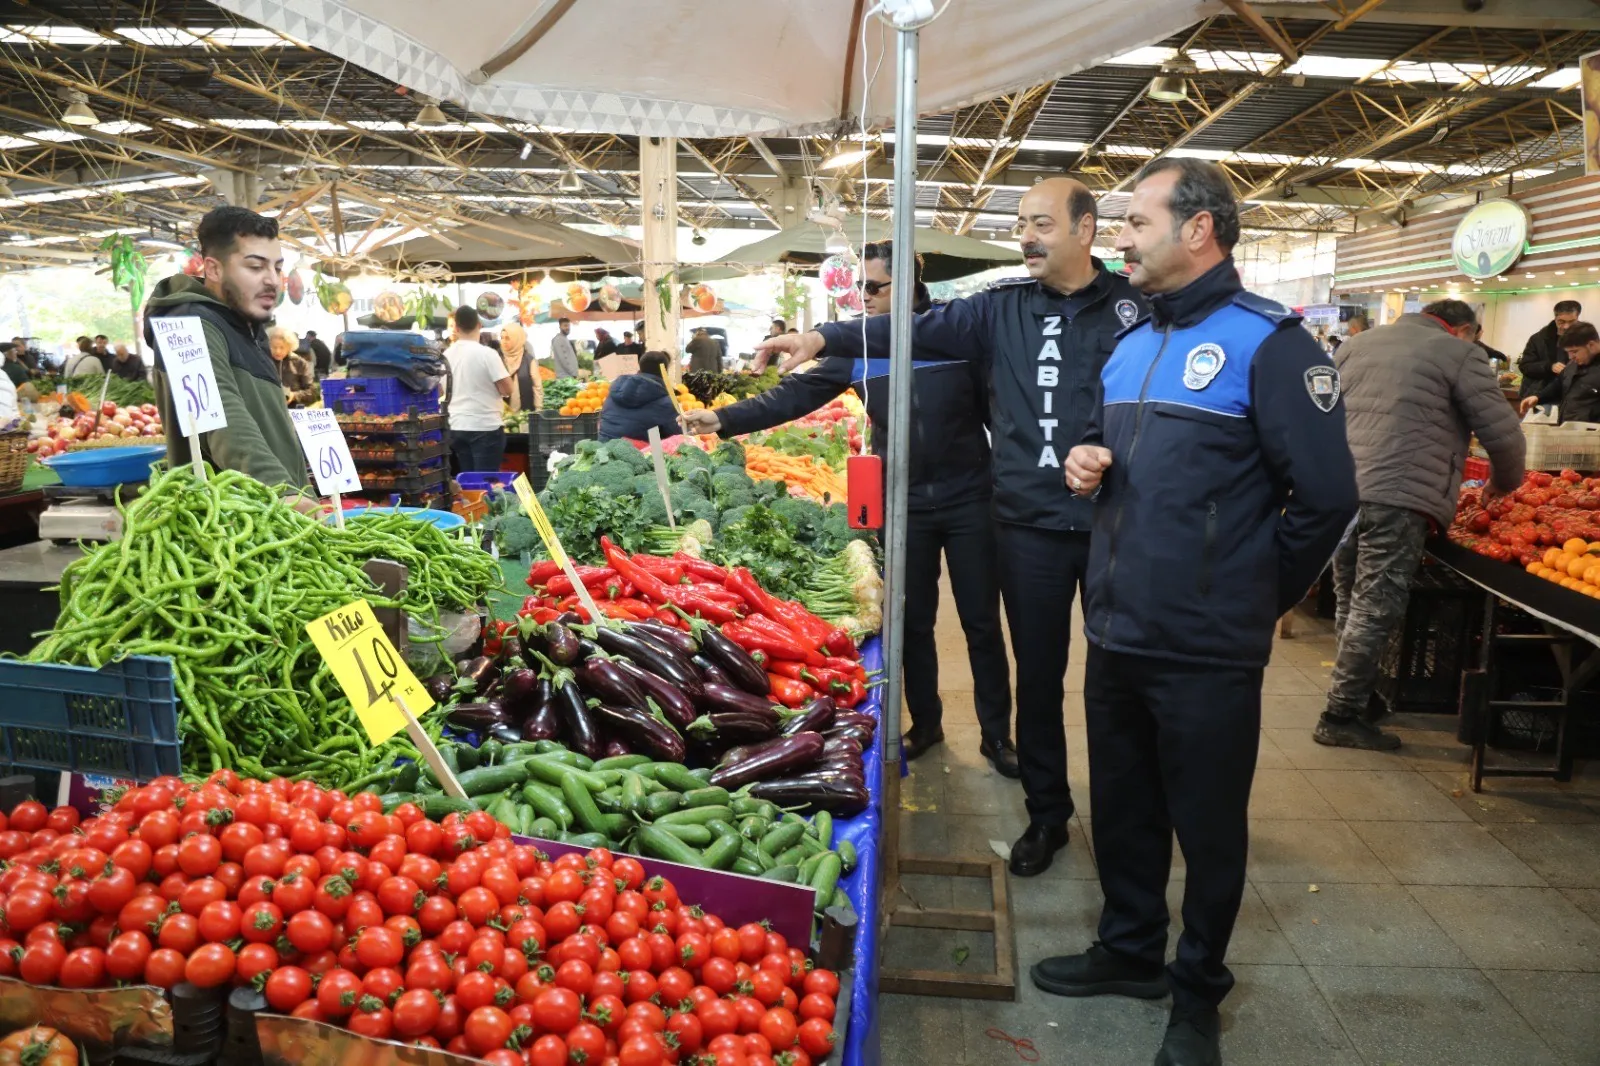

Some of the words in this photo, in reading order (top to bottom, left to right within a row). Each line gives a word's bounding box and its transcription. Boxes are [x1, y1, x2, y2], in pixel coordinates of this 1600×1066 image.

[178, 347, 204, 363] YARIM
[182, 373, 209, 420] 50
[1037, 316, 1062, 468] ZABITA
[319, 446, 343, 479] 60
[352, 637, 398, 709] 40
